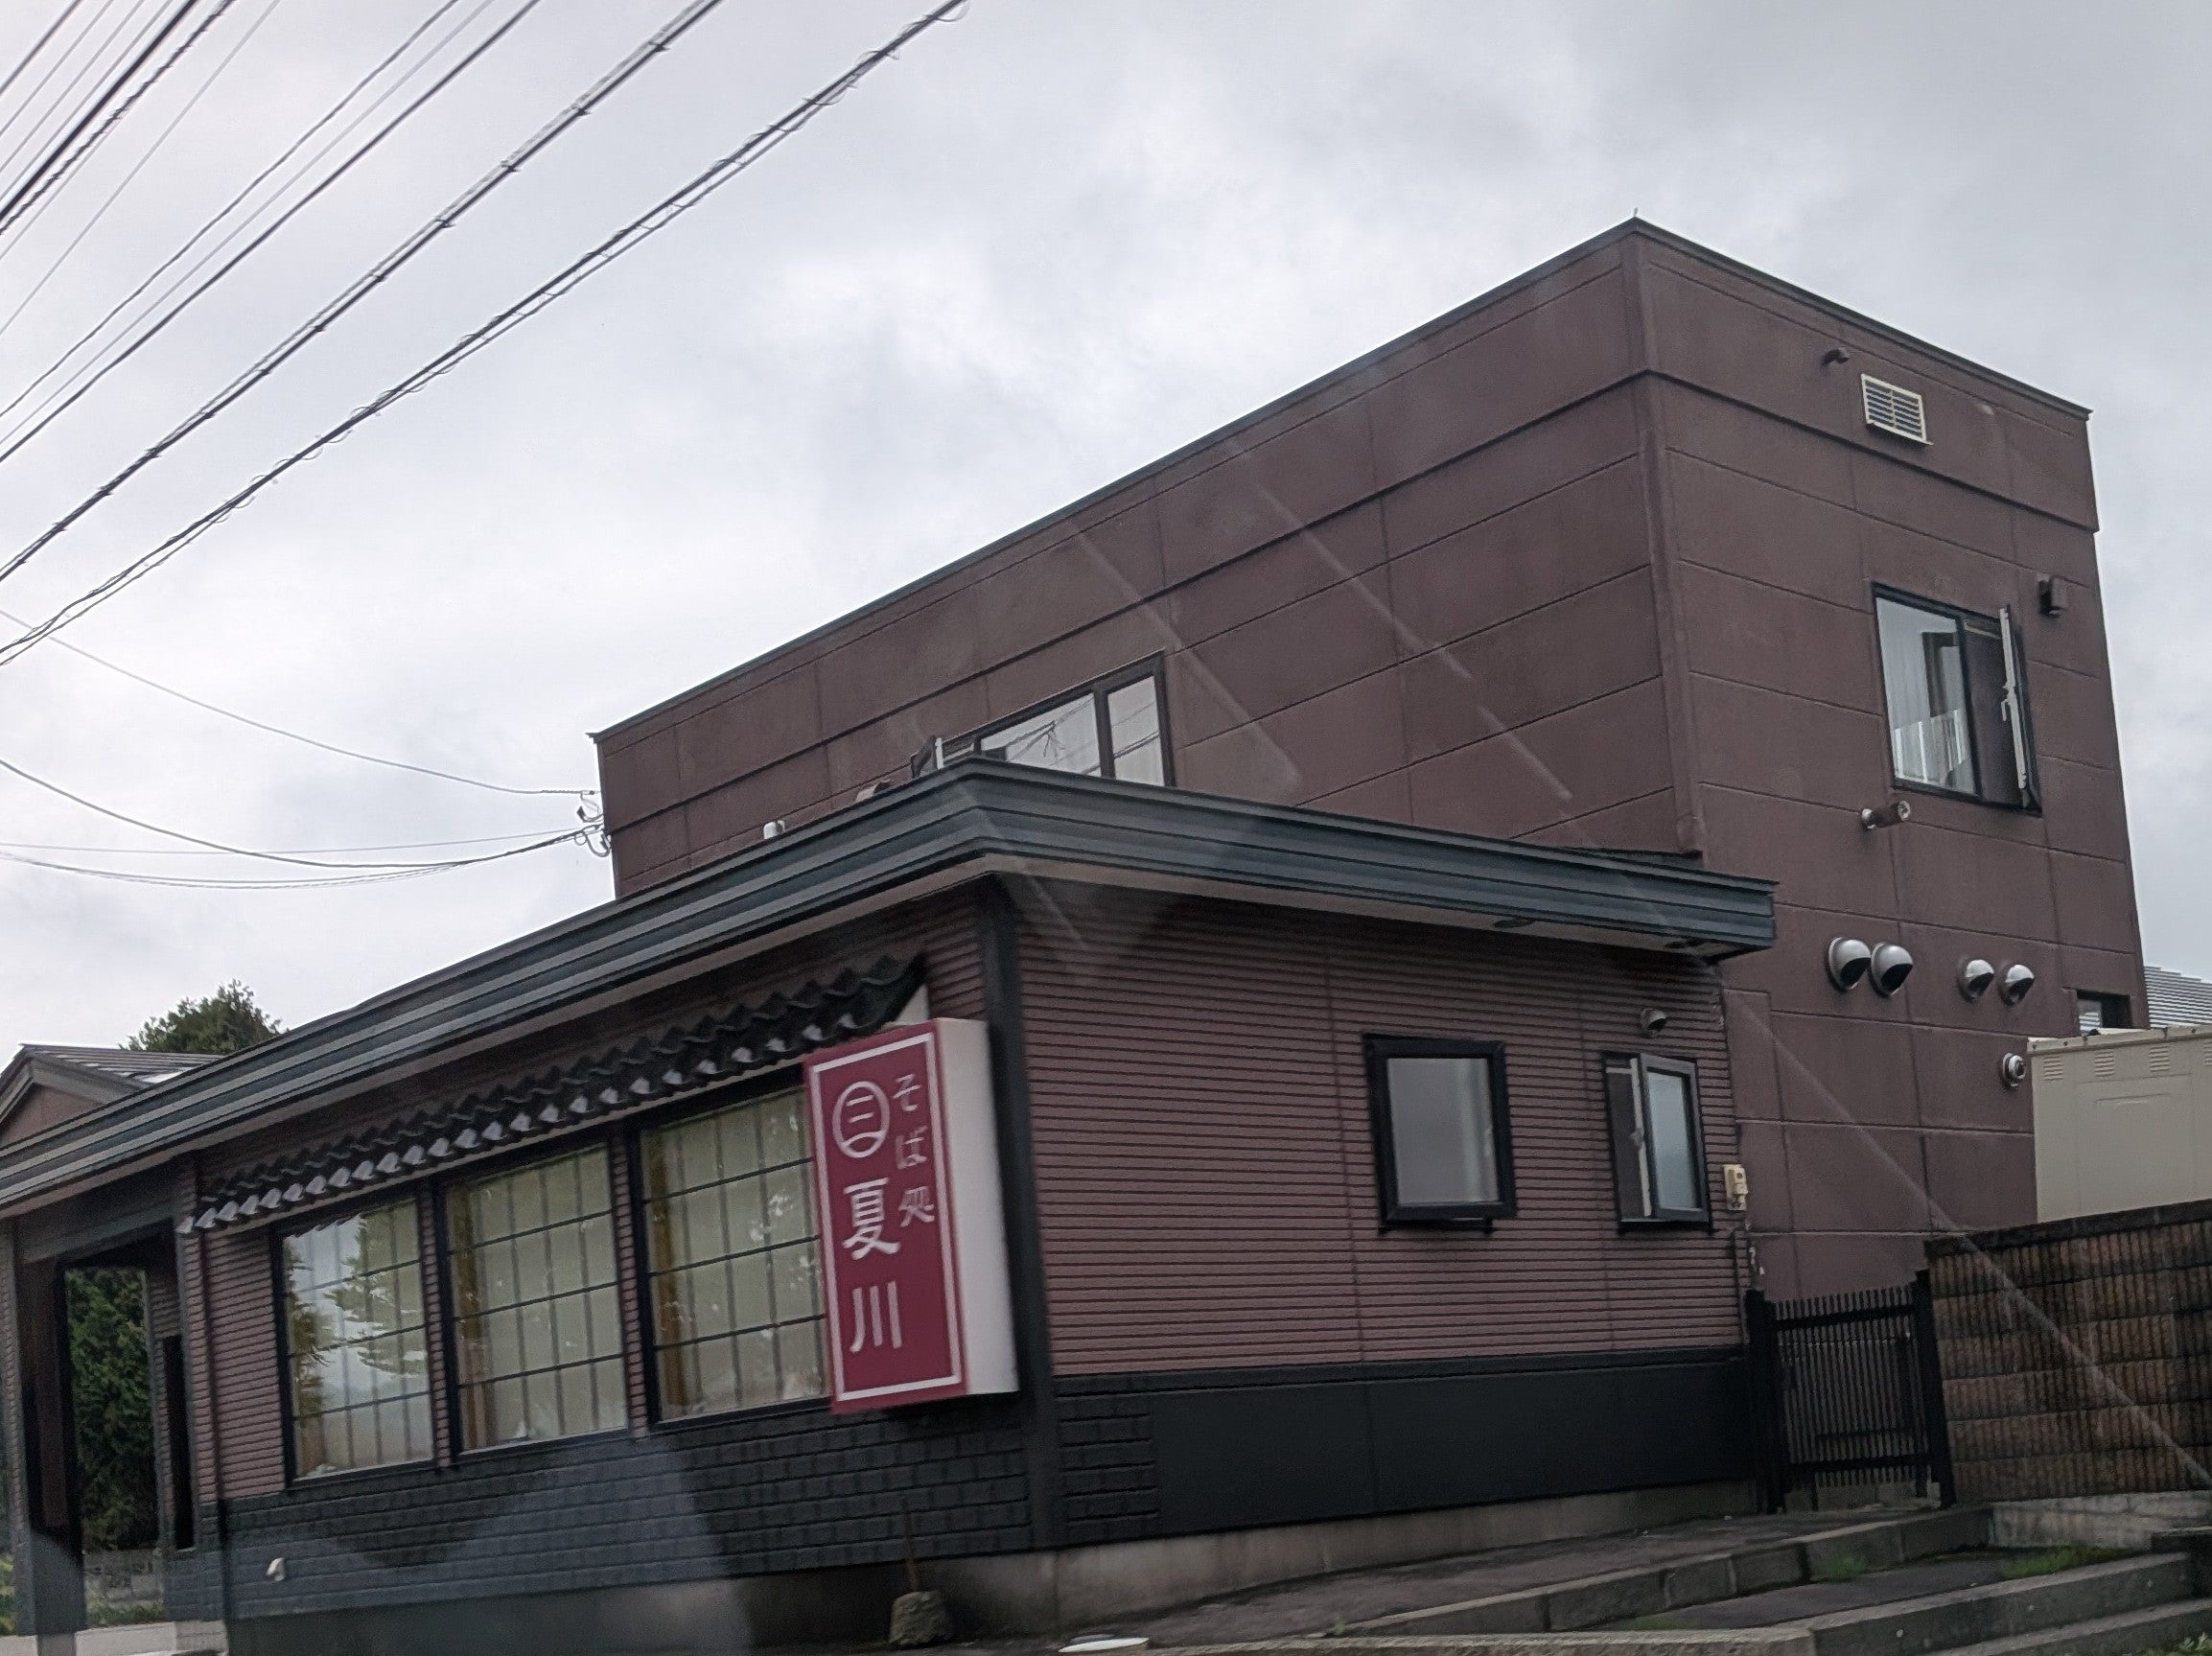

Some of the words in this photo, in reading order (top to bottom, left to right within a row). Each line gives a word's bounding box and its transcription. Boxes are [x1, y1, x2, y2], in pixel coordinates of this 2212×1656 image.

[894, 1073, 936, 1227] そば処
[842, 1177, 901, 1353] 夏川
